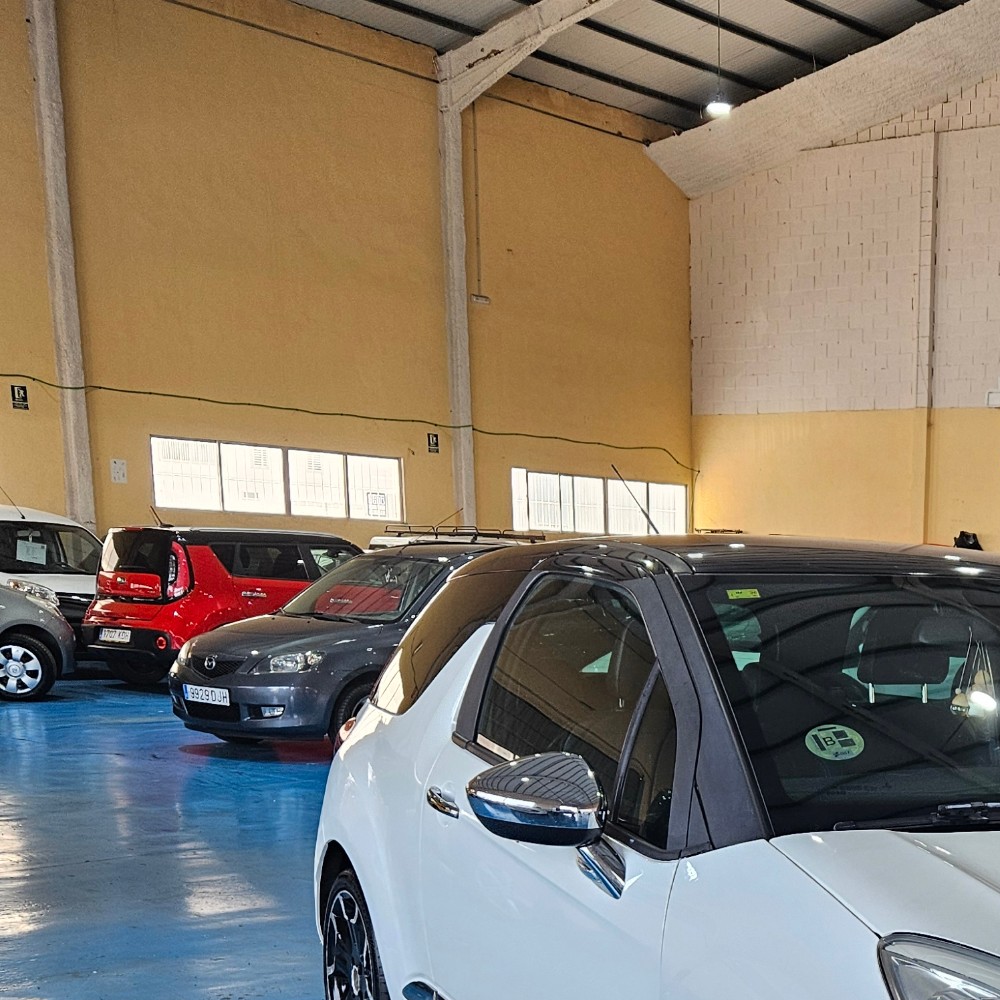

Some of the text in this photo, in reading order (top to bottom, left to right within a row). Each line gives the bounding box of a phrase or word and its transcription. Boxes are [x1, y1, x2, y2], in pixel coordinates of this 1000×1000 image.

[190, 687, 228, 703] 9929 DJH
[822, 736, 836, 746] B
